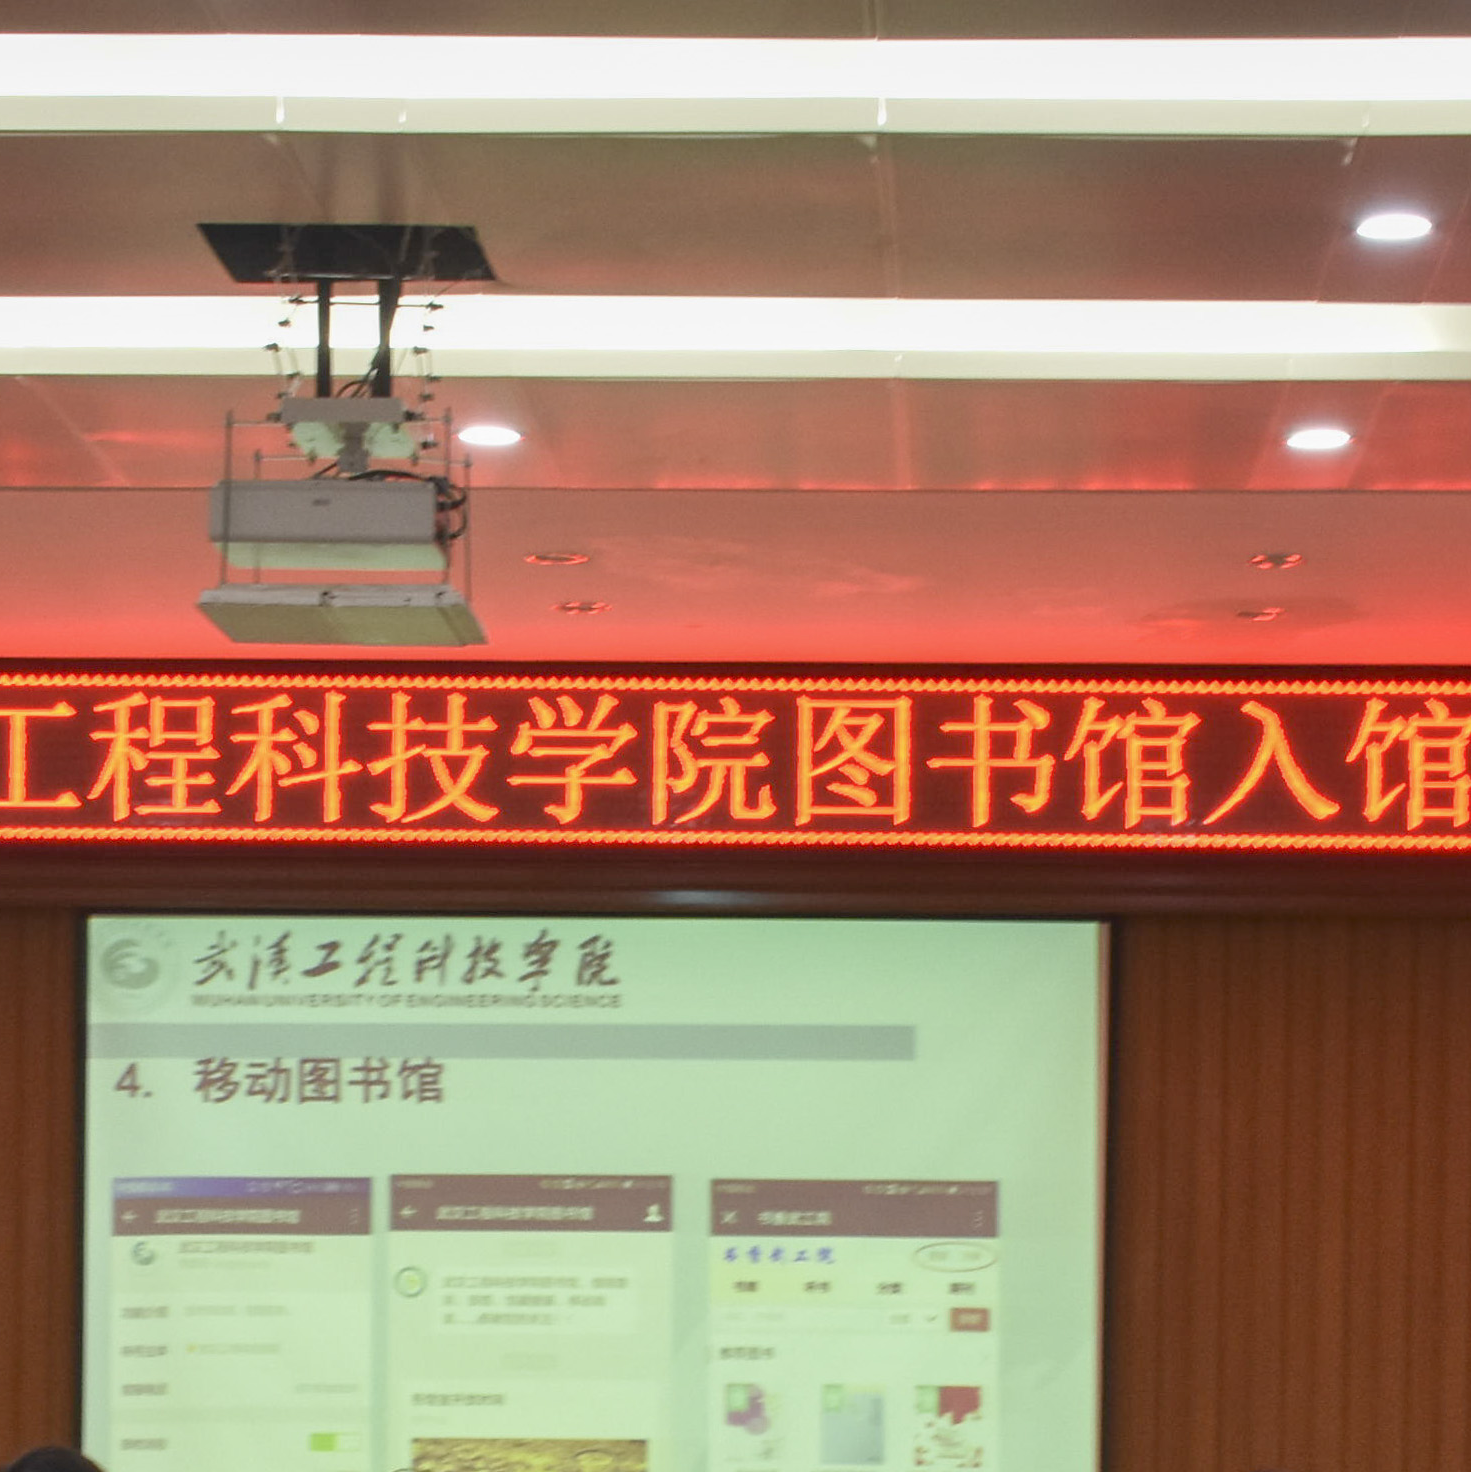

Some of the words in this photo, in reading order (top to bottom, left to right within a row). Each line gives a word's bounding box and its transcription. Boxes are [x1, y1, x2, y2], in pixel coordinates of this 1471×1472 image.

[263, 994, 376, 1009] UNIVERSITY
[378, 994, 403, 1009] OF
[405, 994, 537, 1009] ENGINEERING
[539, 994, 622, 1009] SCIENCE
[115, 1061, 154, 1100] 4.
[193, 1056, 445, 1105] 移动图书馆
